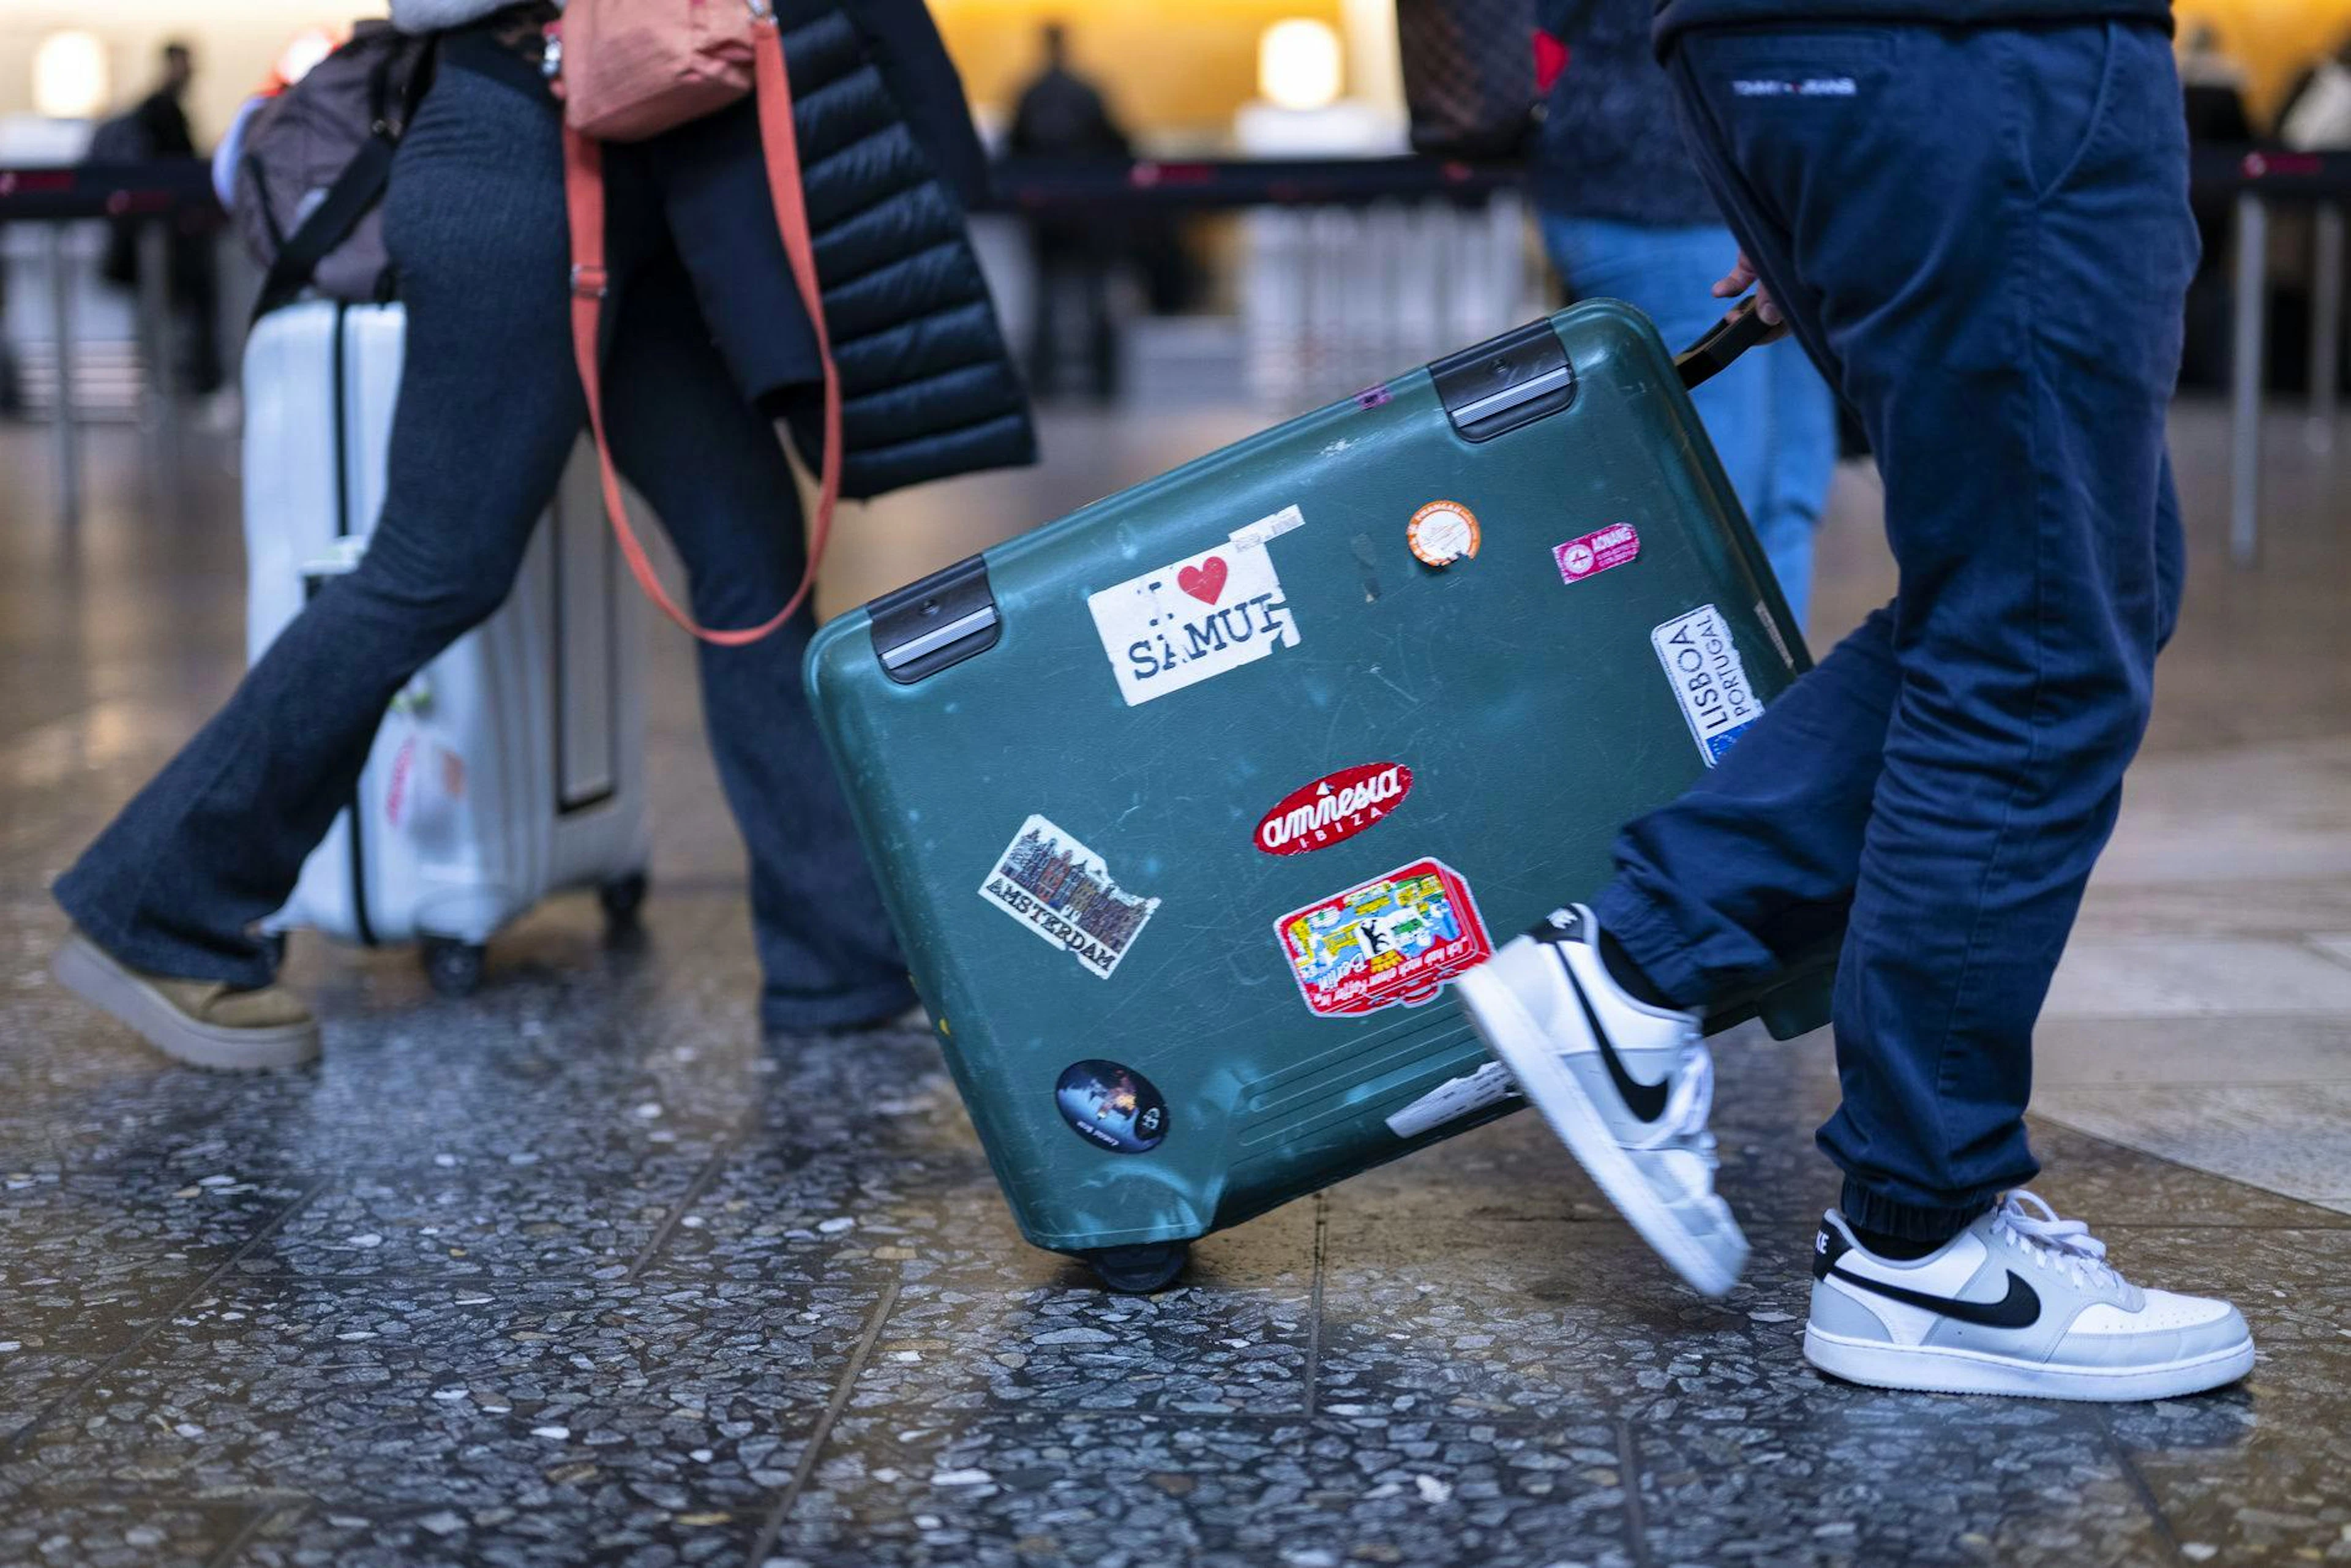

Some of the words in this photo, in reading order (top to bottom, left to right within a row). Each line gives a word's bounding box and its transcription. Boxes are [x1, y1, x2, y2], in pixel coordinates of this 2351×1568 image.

[1668, 624, 1728, 730] LISBOA
[1697, 614, 1750, 717] PORTUGAL
[1299, 807, 1383, 849] IBIZA
[987, 878, 1116, 972] AMSTERDAM
